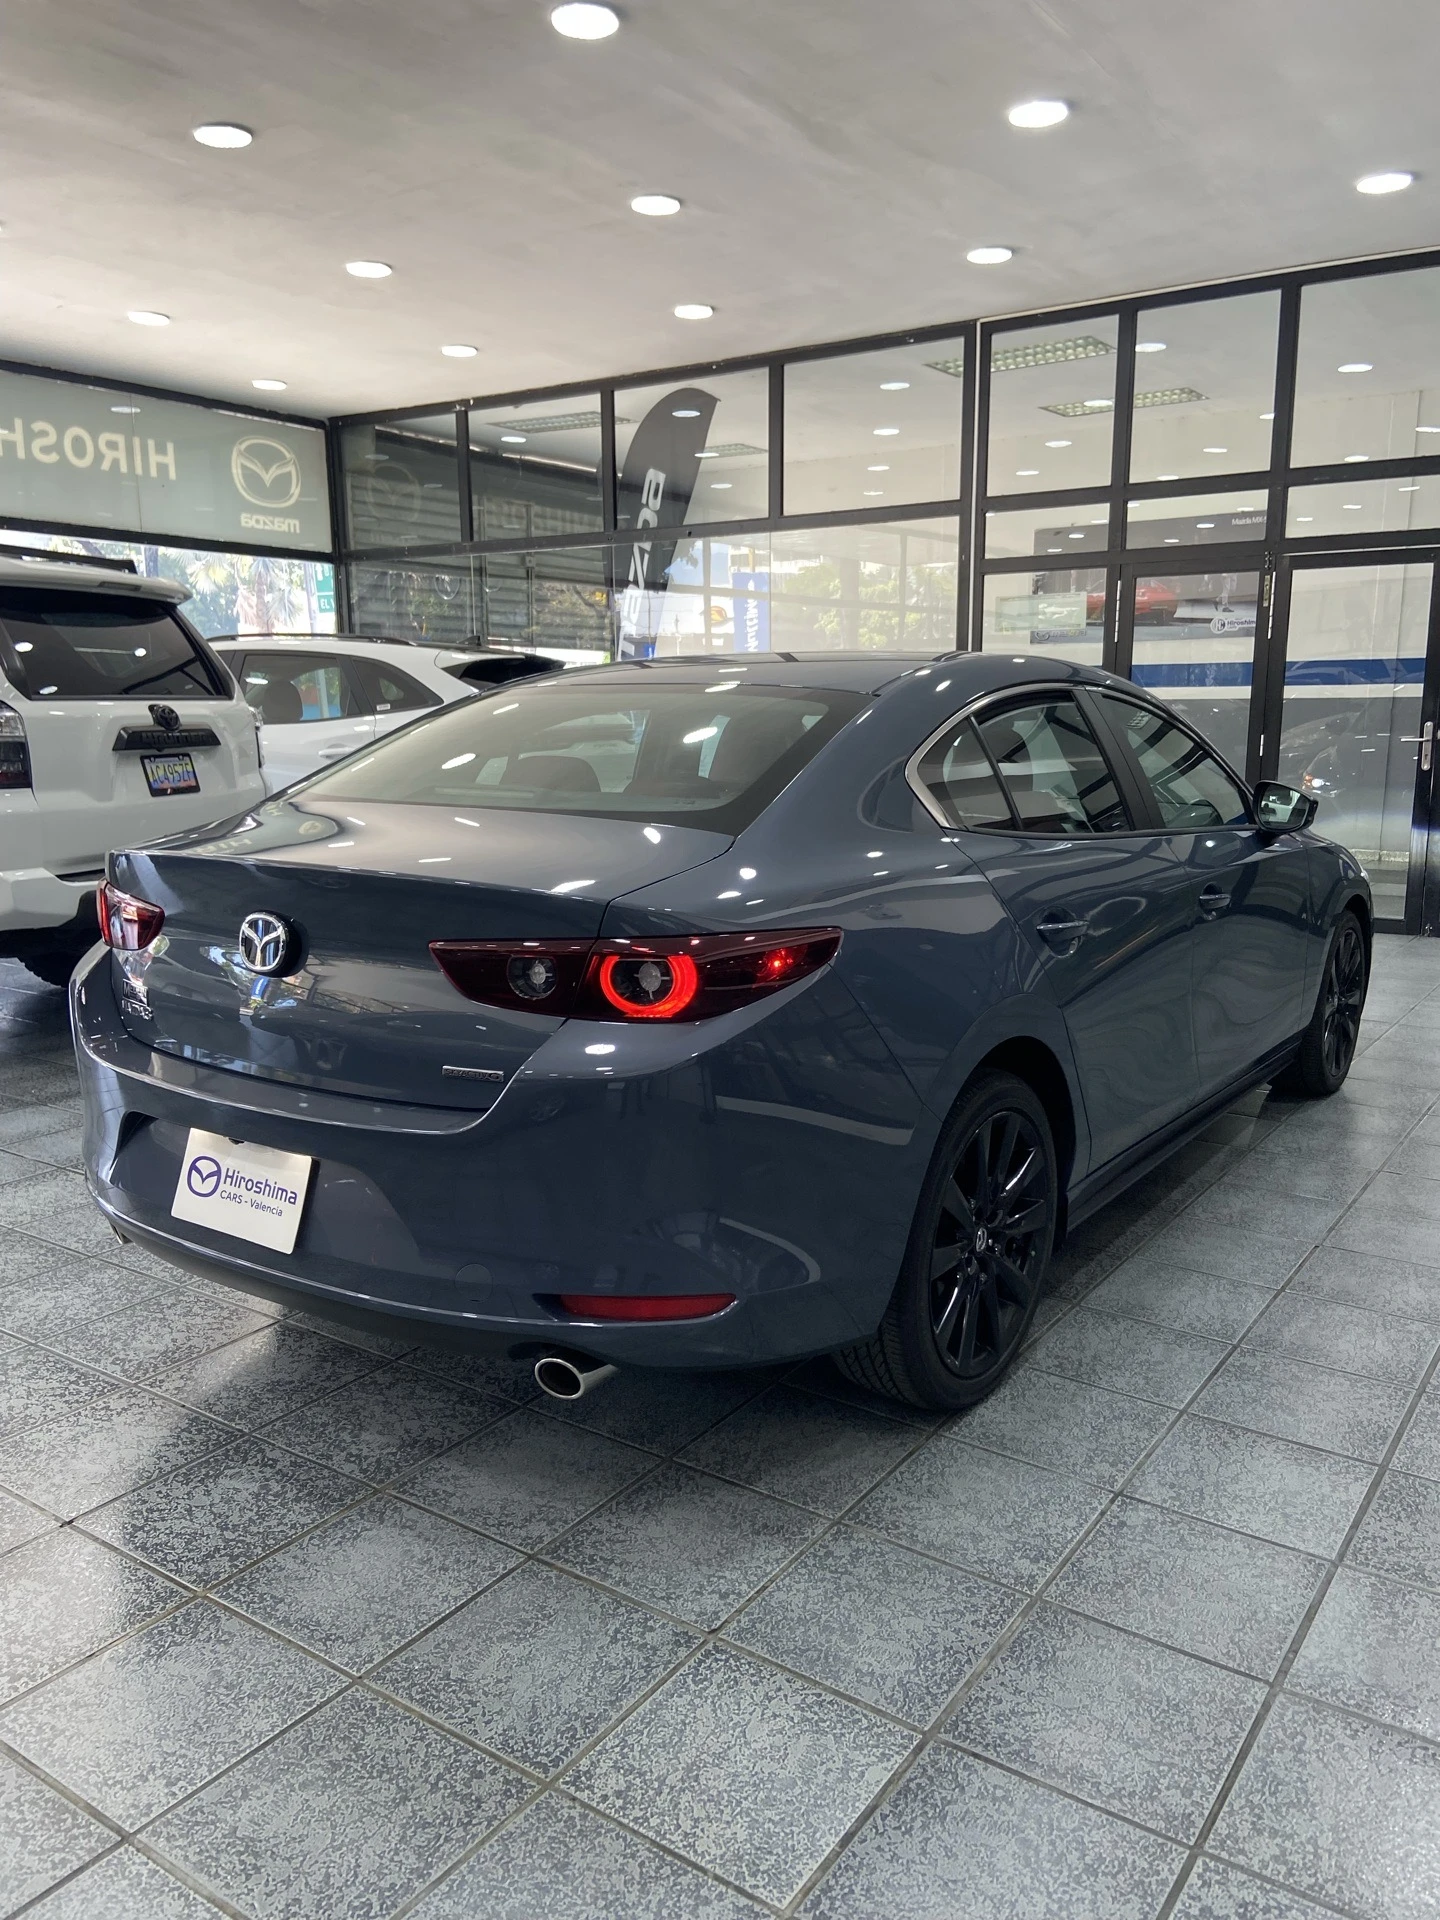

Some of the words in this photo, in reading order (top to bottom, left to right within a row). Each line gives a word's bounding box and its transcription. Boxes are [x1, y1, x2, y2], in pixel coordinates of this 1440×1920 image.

[220, 1189, 243, 1204] CARS
[250, 1198, 283, 1217] Valencia
[223, 1167, 298, 1206] Hiroshima
